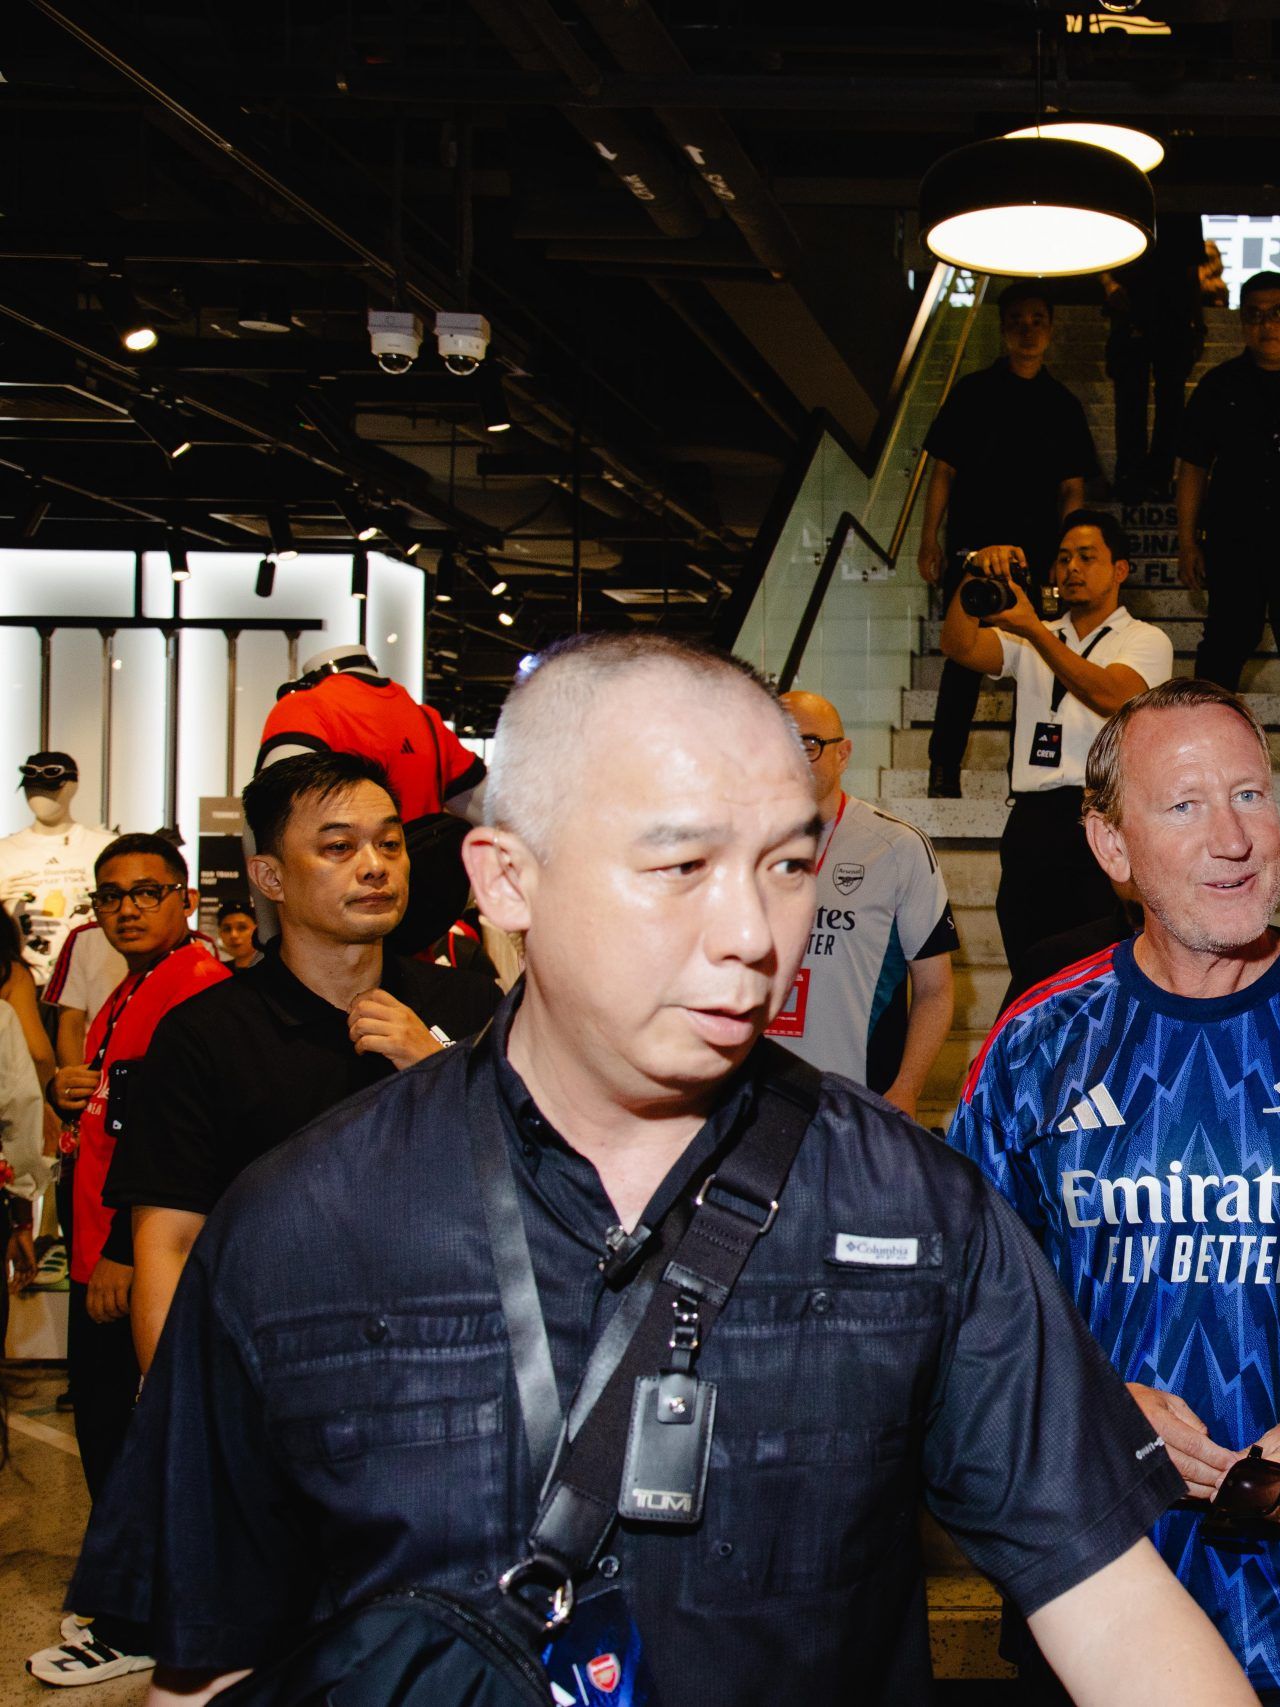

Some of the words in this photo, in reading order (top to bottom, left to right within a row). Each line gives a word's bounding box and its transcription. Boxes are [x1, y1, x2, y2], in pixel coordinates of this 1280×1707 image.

[1145, 562, 1178, 583] FL
[1036, 749, 1056, 759] CREW
[816, 905, 856, 931] tes
[807, 933, 836, 956] TER
[857, 1241, 908, 1255] Columbia
[1104, 1236, 1160, 1284] FLY
[632, 1488, 693, 1513] TUMI
